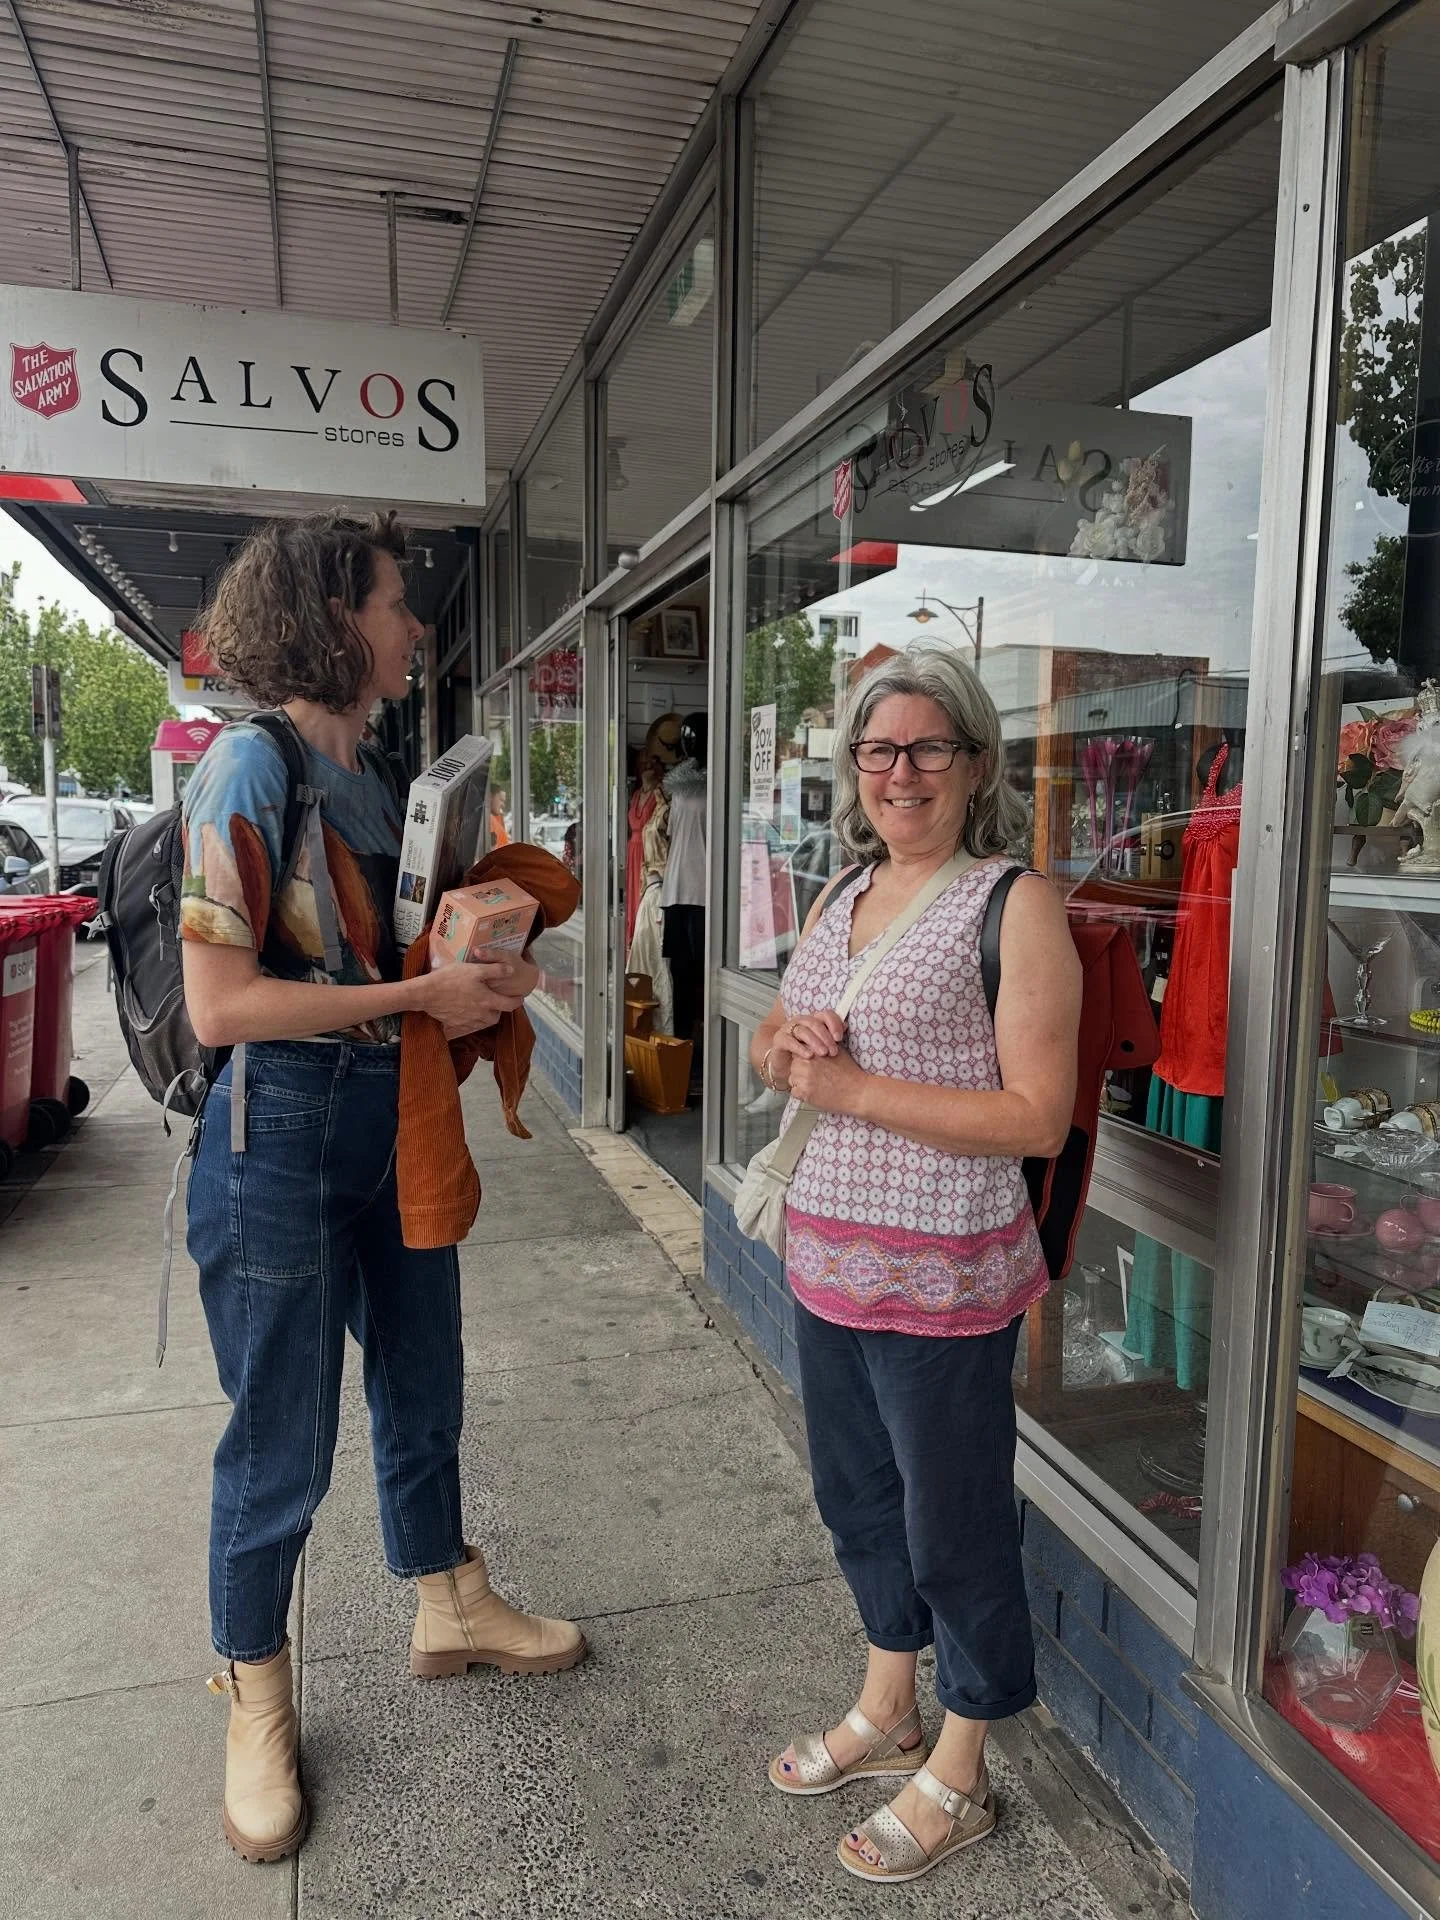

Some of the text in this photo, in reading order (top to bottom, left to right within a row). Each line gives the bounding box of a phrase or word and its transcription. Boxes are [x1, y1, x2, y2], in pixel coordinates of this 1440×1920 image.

[22, 350, 48, 372] THE
[14, 355, 72, 398] SALVATION
[37, 377, 72, 409] ARMY
[100, 348, 459, 452] SALVOS
[324, 425, 405, 447] stores
[928, 438, 966, 472] stores
[753, 727, 772, 749] 20%
[427, 758, 466, 783] 1000
[754, 750, 772, 772] OFF
